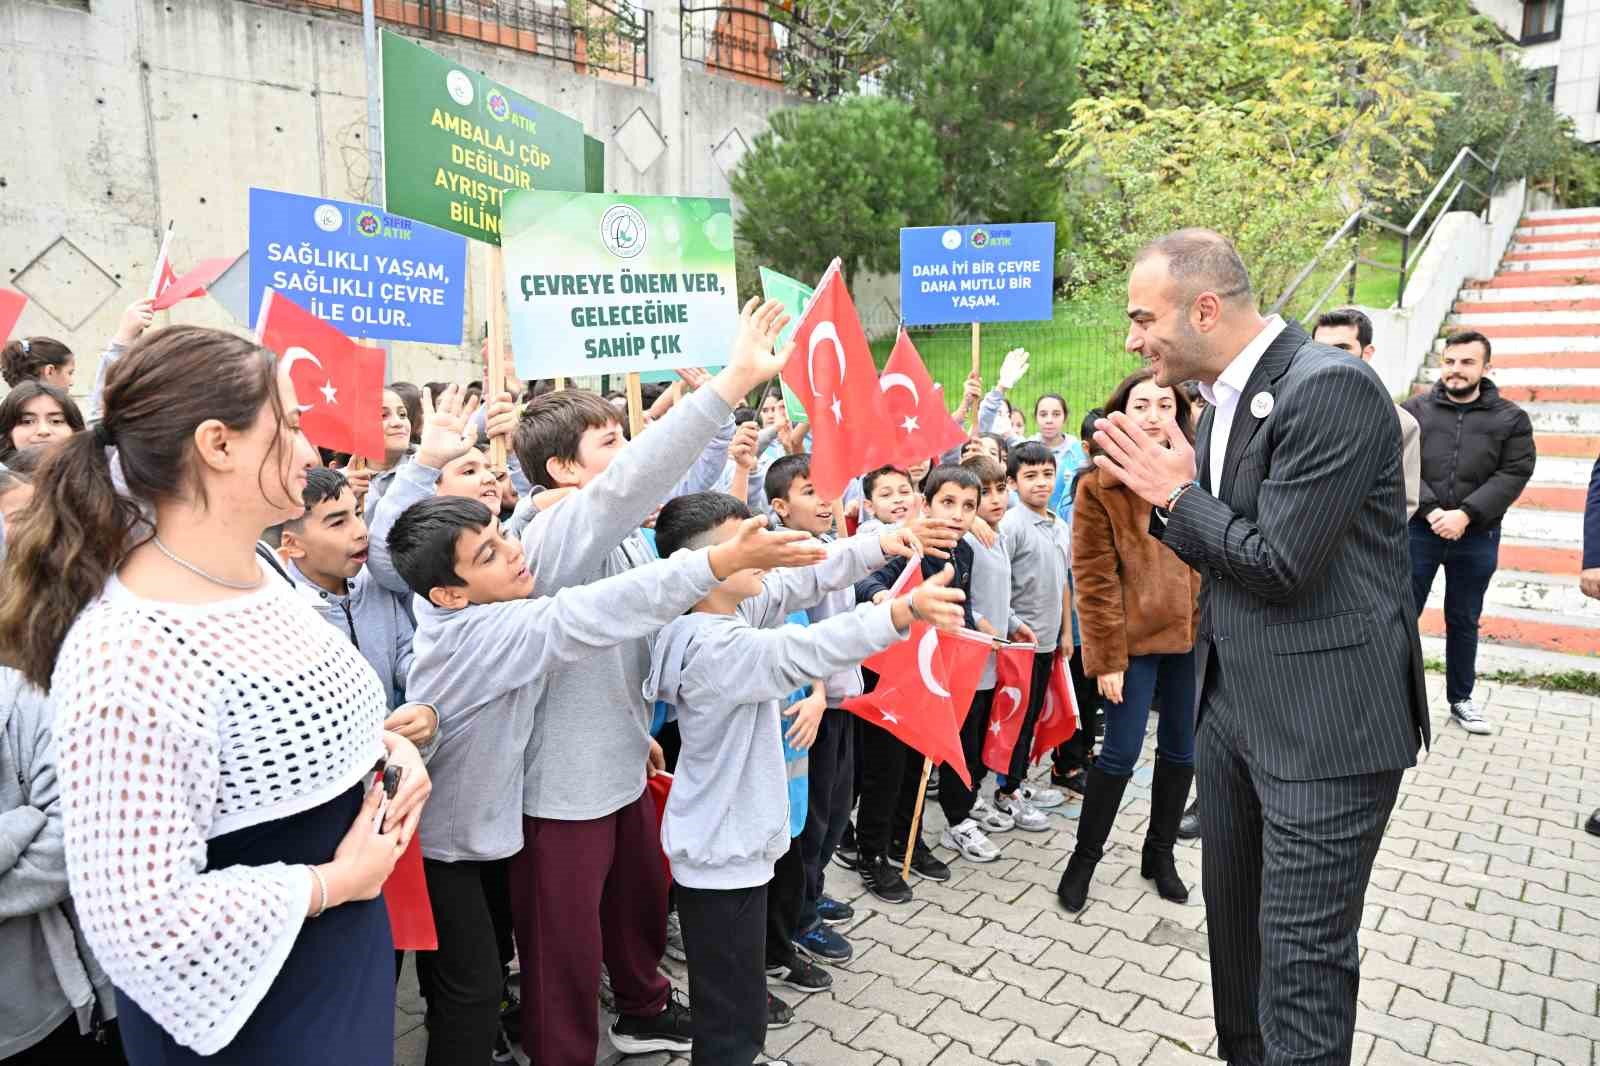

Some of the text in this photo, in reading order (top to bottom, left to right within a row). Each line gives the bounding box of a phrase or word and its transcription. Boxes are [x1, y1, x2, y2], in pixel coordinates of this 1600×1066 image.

[431, 108, 551, 171] AMBALAJ ÇÖP
[451, 143, 536, 191] DEĞİLDİR.
[267, 242, 449, 284] SAĞLIKLI YAŞAM,
[912, 259, 1041, 277] DAHA İYİ BİR ÇEVRE
[273, 270, 445, 306] SAĞLIKLI ÇEVRE
[520, 268, 726, 302] ÇEVREYE ÖNEM VER,
[920, 274, 1032, 293] DAHA MUTLU BİR
[311, 297, 412, 328] İLE OLUR.
[571, 300, 689, 328] GELECEĞİNE
[952, 294, 1000, 309] YAŞAM.
[584, 332, 682, 360] SAHİP ÇIK
